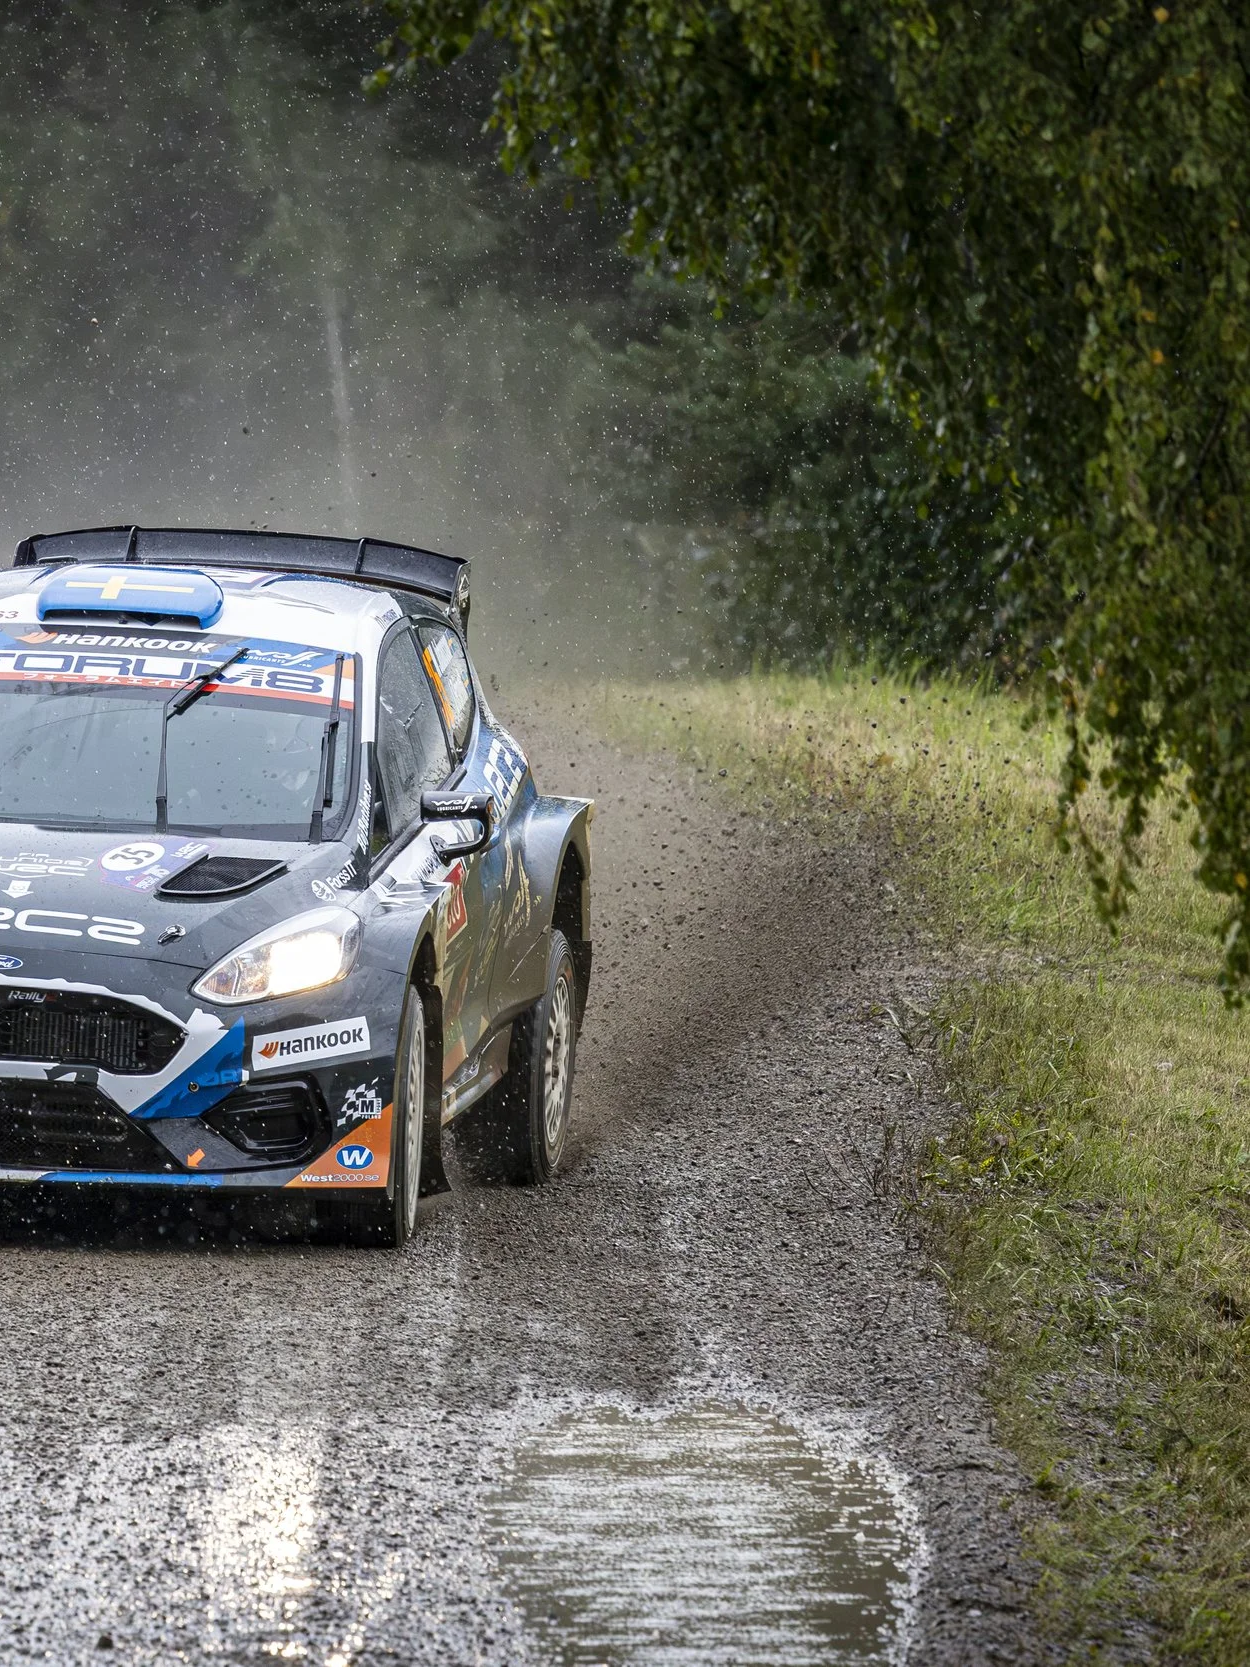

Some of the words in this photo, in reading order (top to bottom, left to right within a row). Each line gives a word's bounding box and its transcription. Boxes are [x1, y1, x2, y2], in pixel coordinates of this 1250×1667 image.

[109, 847, 155, 865] 35
[360, 1099, 375, 1113] M
[341, 1149, 369, 1165] W
[300, 1173, 380, 1183] West2000.se
